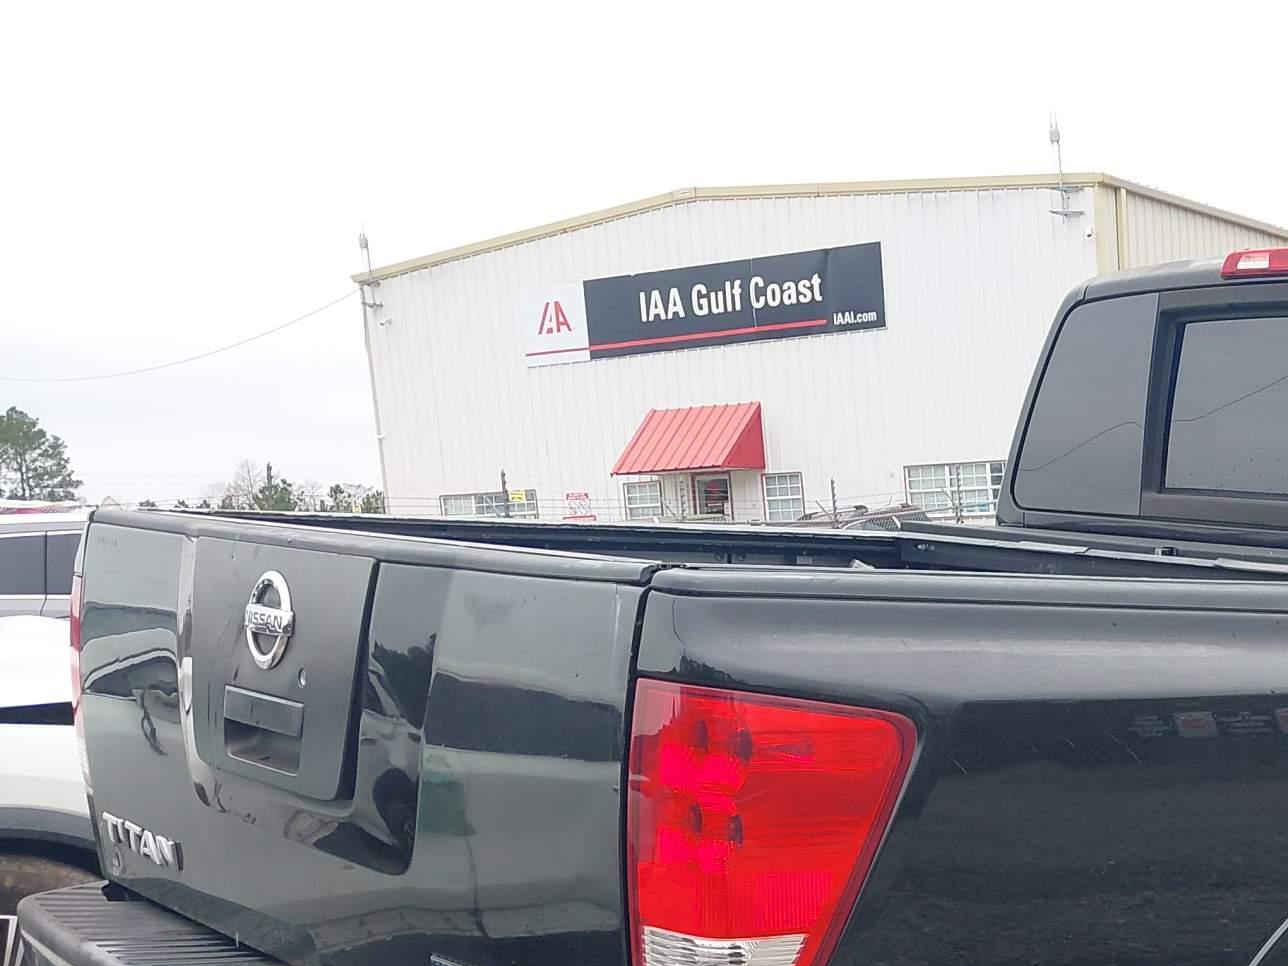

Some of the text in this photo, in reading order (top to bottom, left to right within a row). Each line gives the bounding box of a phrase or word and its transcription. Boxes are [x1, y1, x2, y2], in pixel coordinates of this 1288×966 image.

[638, 272, 823, 323] IAA Gulf Coast
[833, 310, 877, 326] IAAI.com
[247, 608, 284, 632] NISSAN
[102, 811, 184, 872] TITAN
